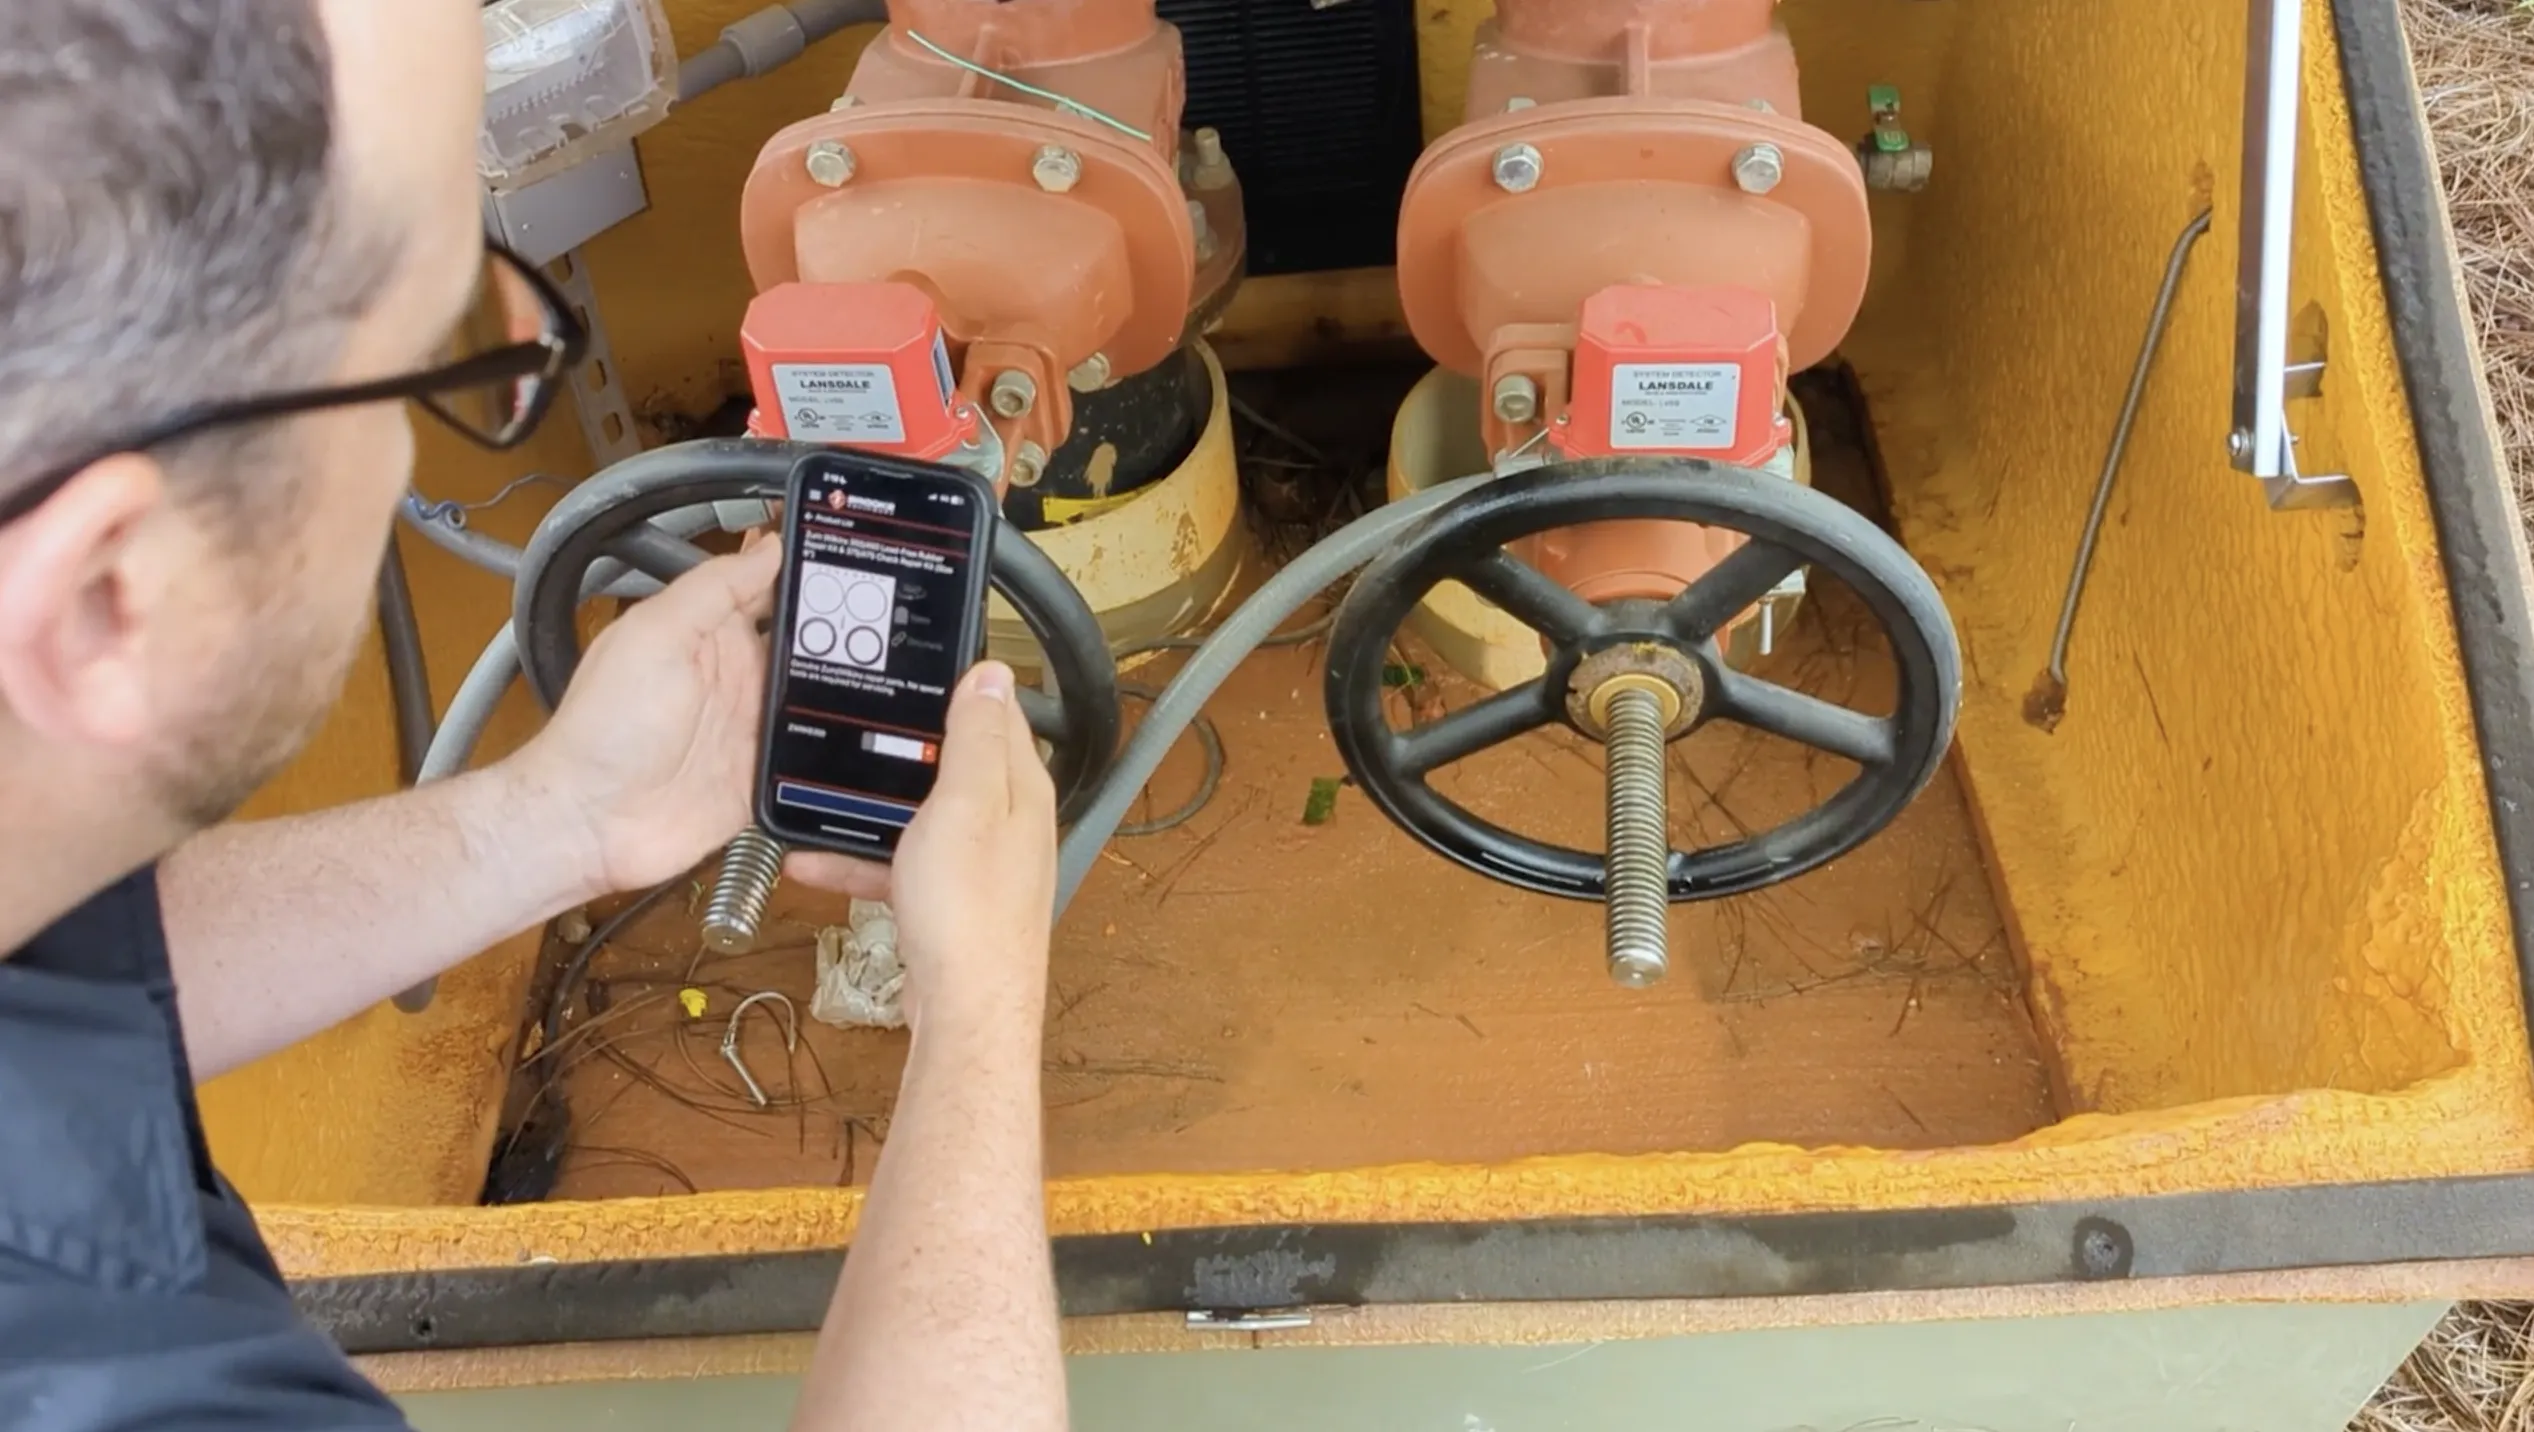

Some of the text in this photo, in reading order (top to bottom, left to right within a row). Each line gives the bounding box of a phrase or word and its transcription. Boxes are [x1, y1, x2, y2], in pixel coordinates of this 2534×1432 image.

[829, 370, 875, 378] DETECTOR
[1633, 370, 1722, 378] SYSTEM DETECTOR
[800, 380, 871, 389] LANSDALE
[1638, 381, 1714, 390] LANSDALE
